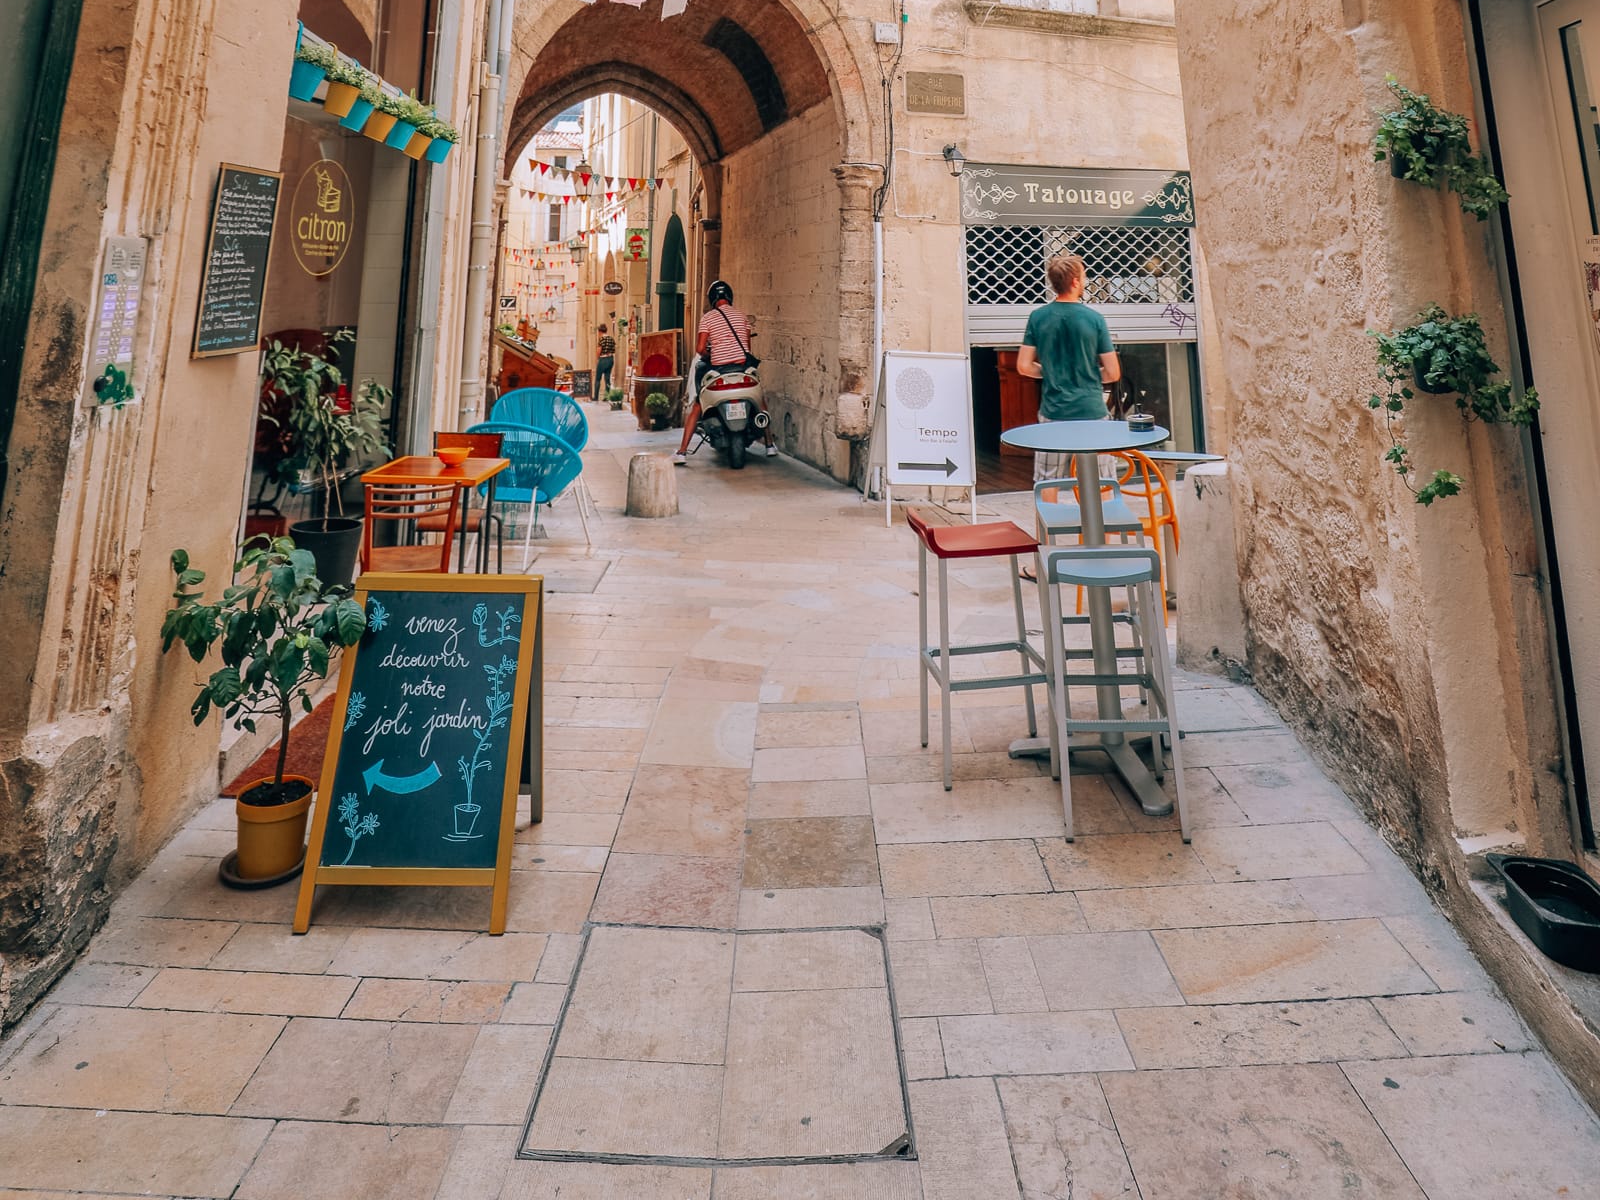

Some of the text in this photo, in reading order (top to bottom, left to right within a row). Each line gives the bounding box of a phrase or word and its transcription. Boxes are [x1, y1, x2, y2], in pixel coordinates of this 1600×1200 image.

[1023, 182, 1135, 210] Tatouage
[298, 212, 346, 242] citron
[918, 427, 958, 438] Tempo
[405, 616, 465, 656] venez
[379, 644, 470, 668] découvrir
[401, 675, 446, 699] notre
[363, 698, 487, 757] joli jardin
